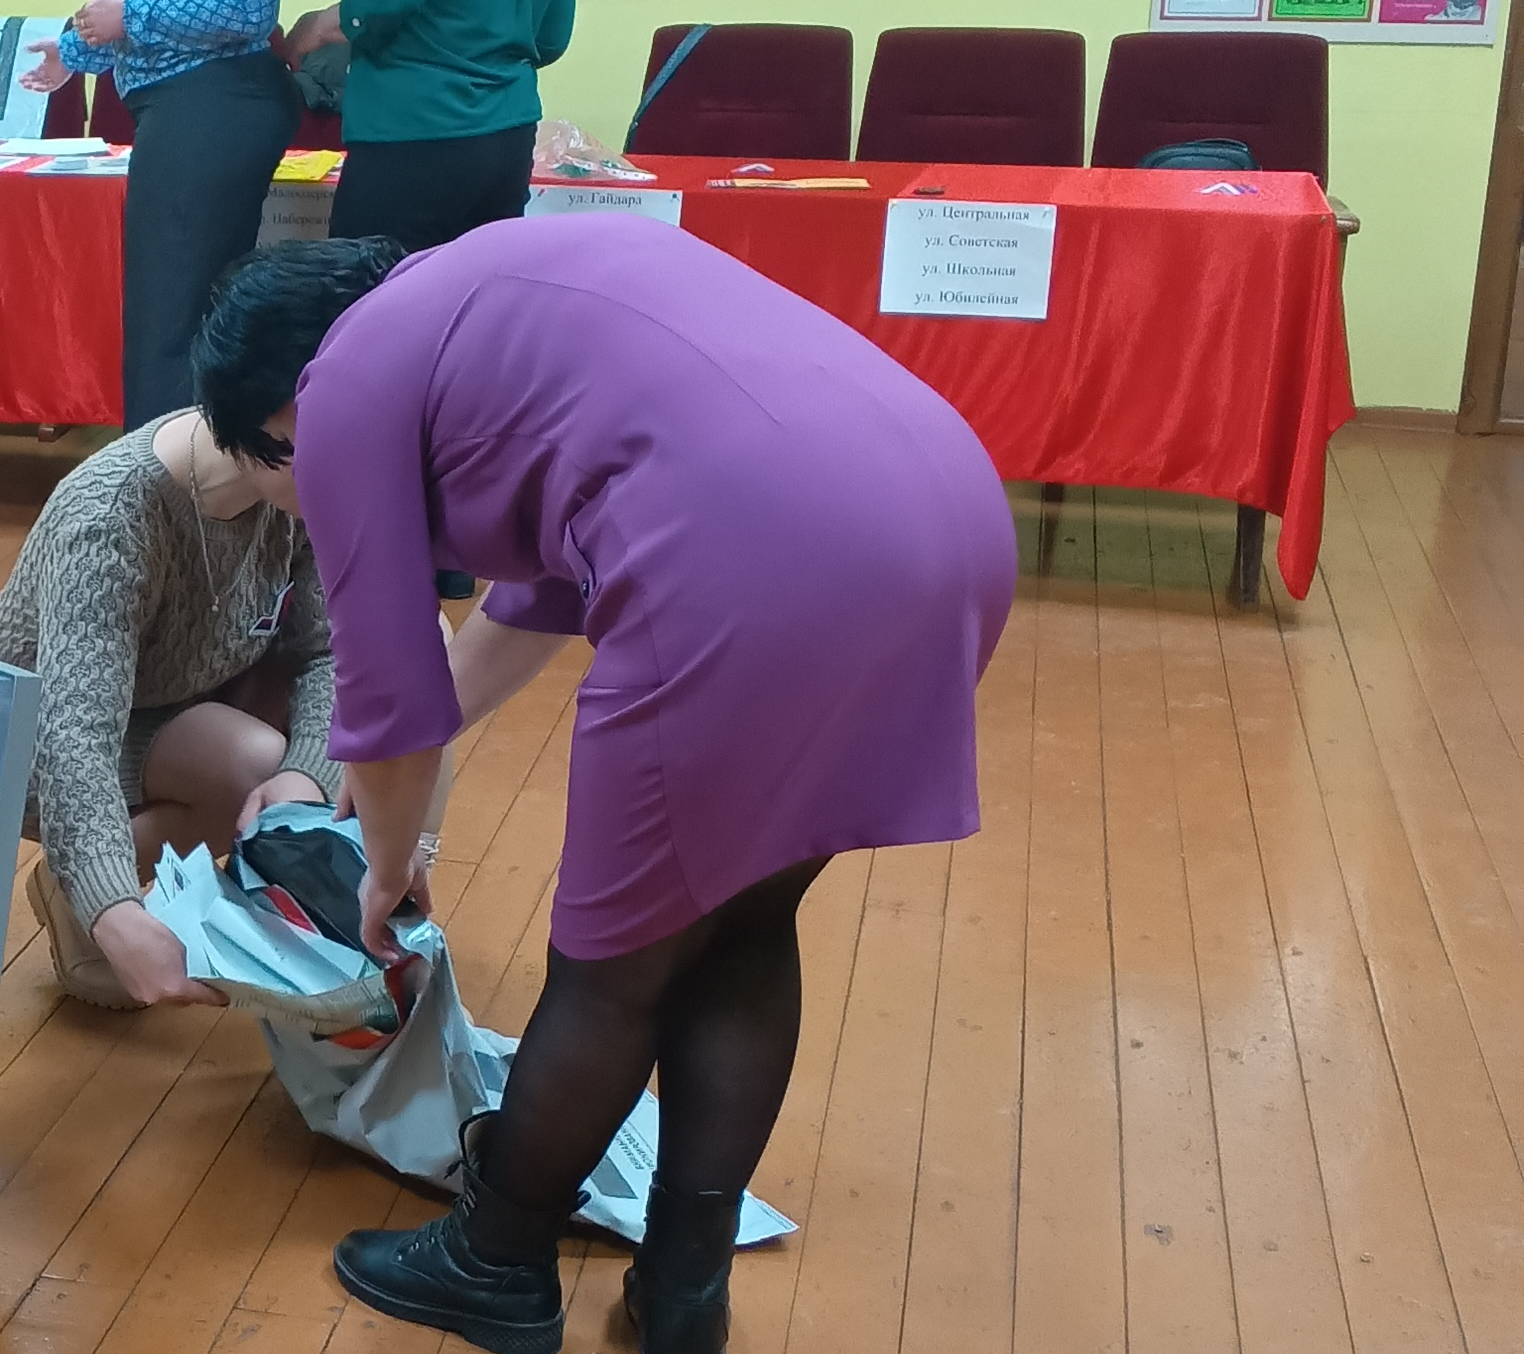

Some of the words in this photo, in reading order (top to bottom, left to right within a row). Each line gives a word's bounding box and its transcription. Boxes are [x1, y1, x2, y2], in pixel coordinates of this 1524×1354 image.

[567, 195, 588, 207] ул.
[591, 192, 642, 207] Гайдара
[918, 208, 937, 220] ул.
[942, 206, 1030, 221] Центральная
[925, 237, 944, 249] ул.
[949, 234, 1018, 248] Советская
[922, 265, 941, 277] ул.
[947, 263, 1016, 276] Школьная
[914, 293, 934, 305] ул.
[939, 291, 1018, 305] Юбилейная
